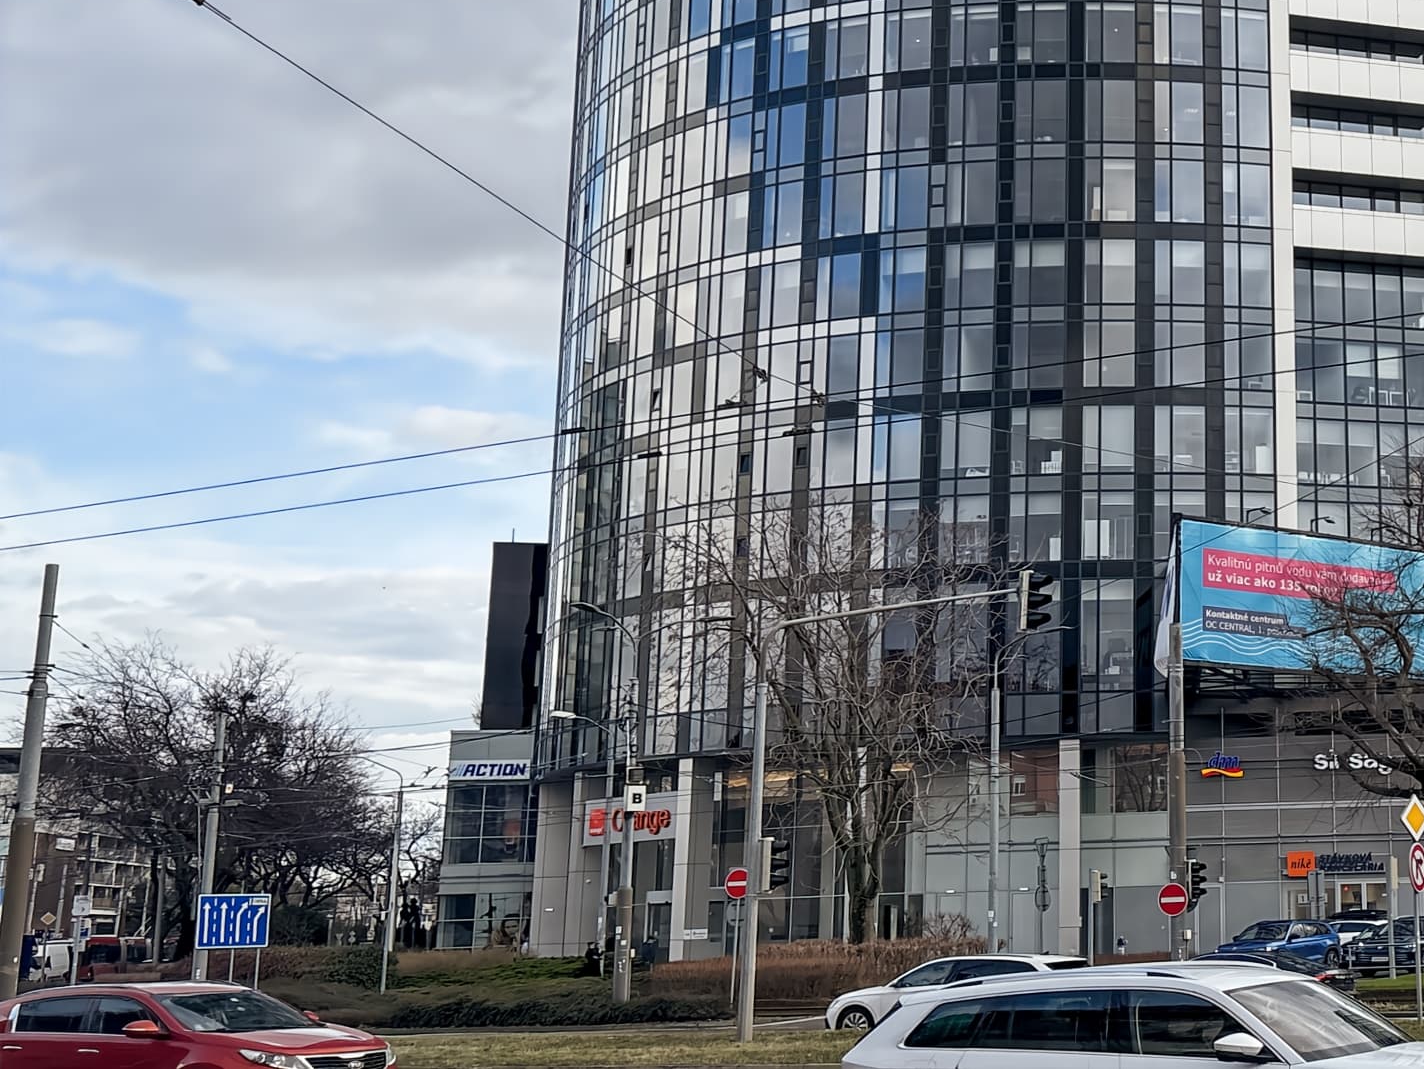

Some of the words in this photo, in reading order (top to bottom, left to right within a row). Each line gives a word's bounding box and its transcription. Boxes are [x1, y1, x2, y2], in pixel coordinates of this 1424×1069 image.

[1207, 554, 1252, 571] Kvalitnú
[1287, 566, 1312, 578] vodu
[1207, 570, 1223, 583] už
[1225, 572, 1251, 586] viac
[1254, 575, 1277, 589] ako
[1279, 578, 1302, 592] 135
[1205, 609, 1249, 622] Kontaktné
[1250, 615, 1285, 625] centrum
[1205, 620, 1217, 629] OC
[1208, 751, 1240, 769] dm
[462, 763, 527, 778] ACTION
[632, 793, 643, 804] B
[610, 808, 671, 836] Oange
